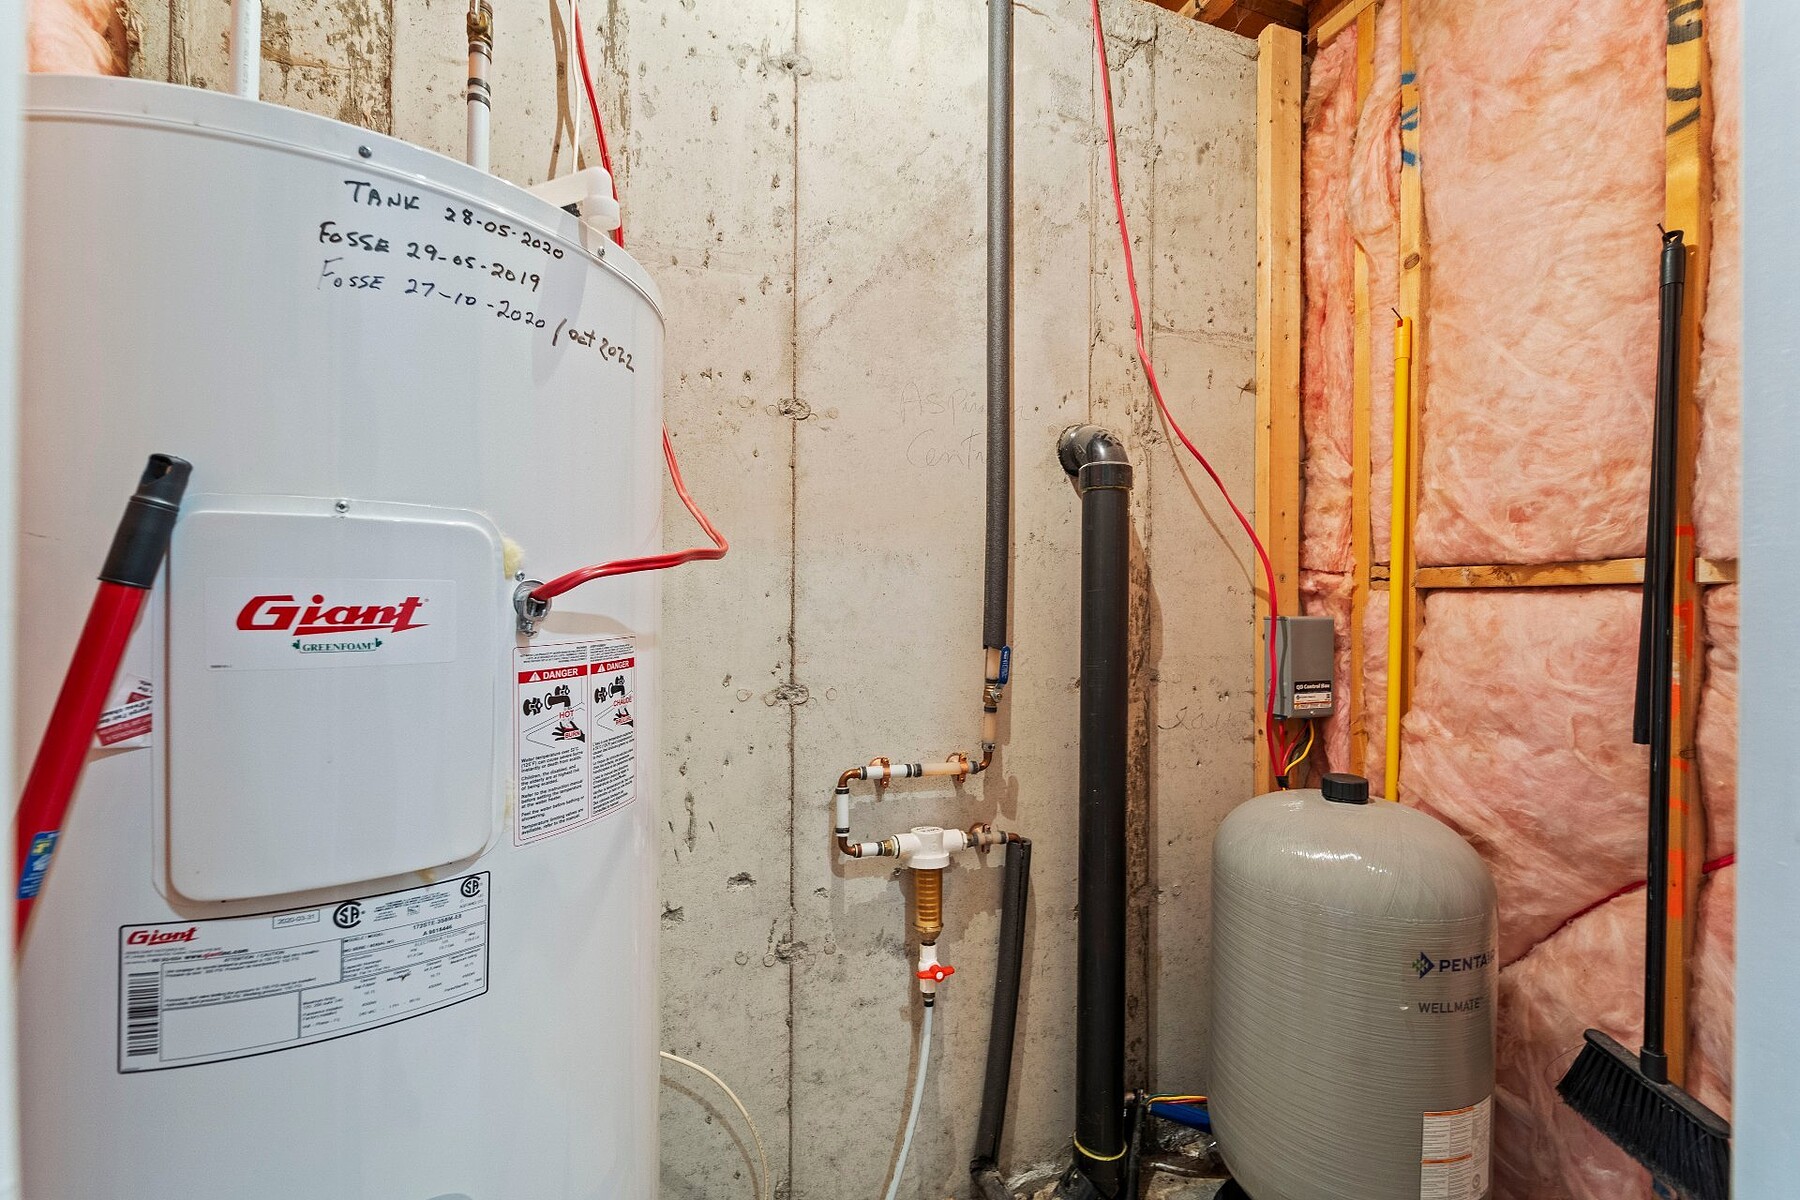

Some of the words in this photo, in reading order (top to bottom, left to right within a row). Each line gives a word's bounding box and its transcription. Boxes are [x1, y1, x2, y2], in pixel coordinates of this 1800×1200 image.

[344, 180, 420, 211] TANK
[444, 207, 565, 260] 28-05-2020
[406, 241, 541, 292] 29-05-2019
[599, 337, 635, 373] 2022
[236, 594, 431, 637] Giant
[302, 641, 373, 652] GREENFOAM
[606, 660, 630, 671] DANGER
[543, 667, 579, 681] DANGER
[559, 709, 574, 719] HOT
[564, 729, 580, 740] BURN
[127, 926, 199, 945] Giant
